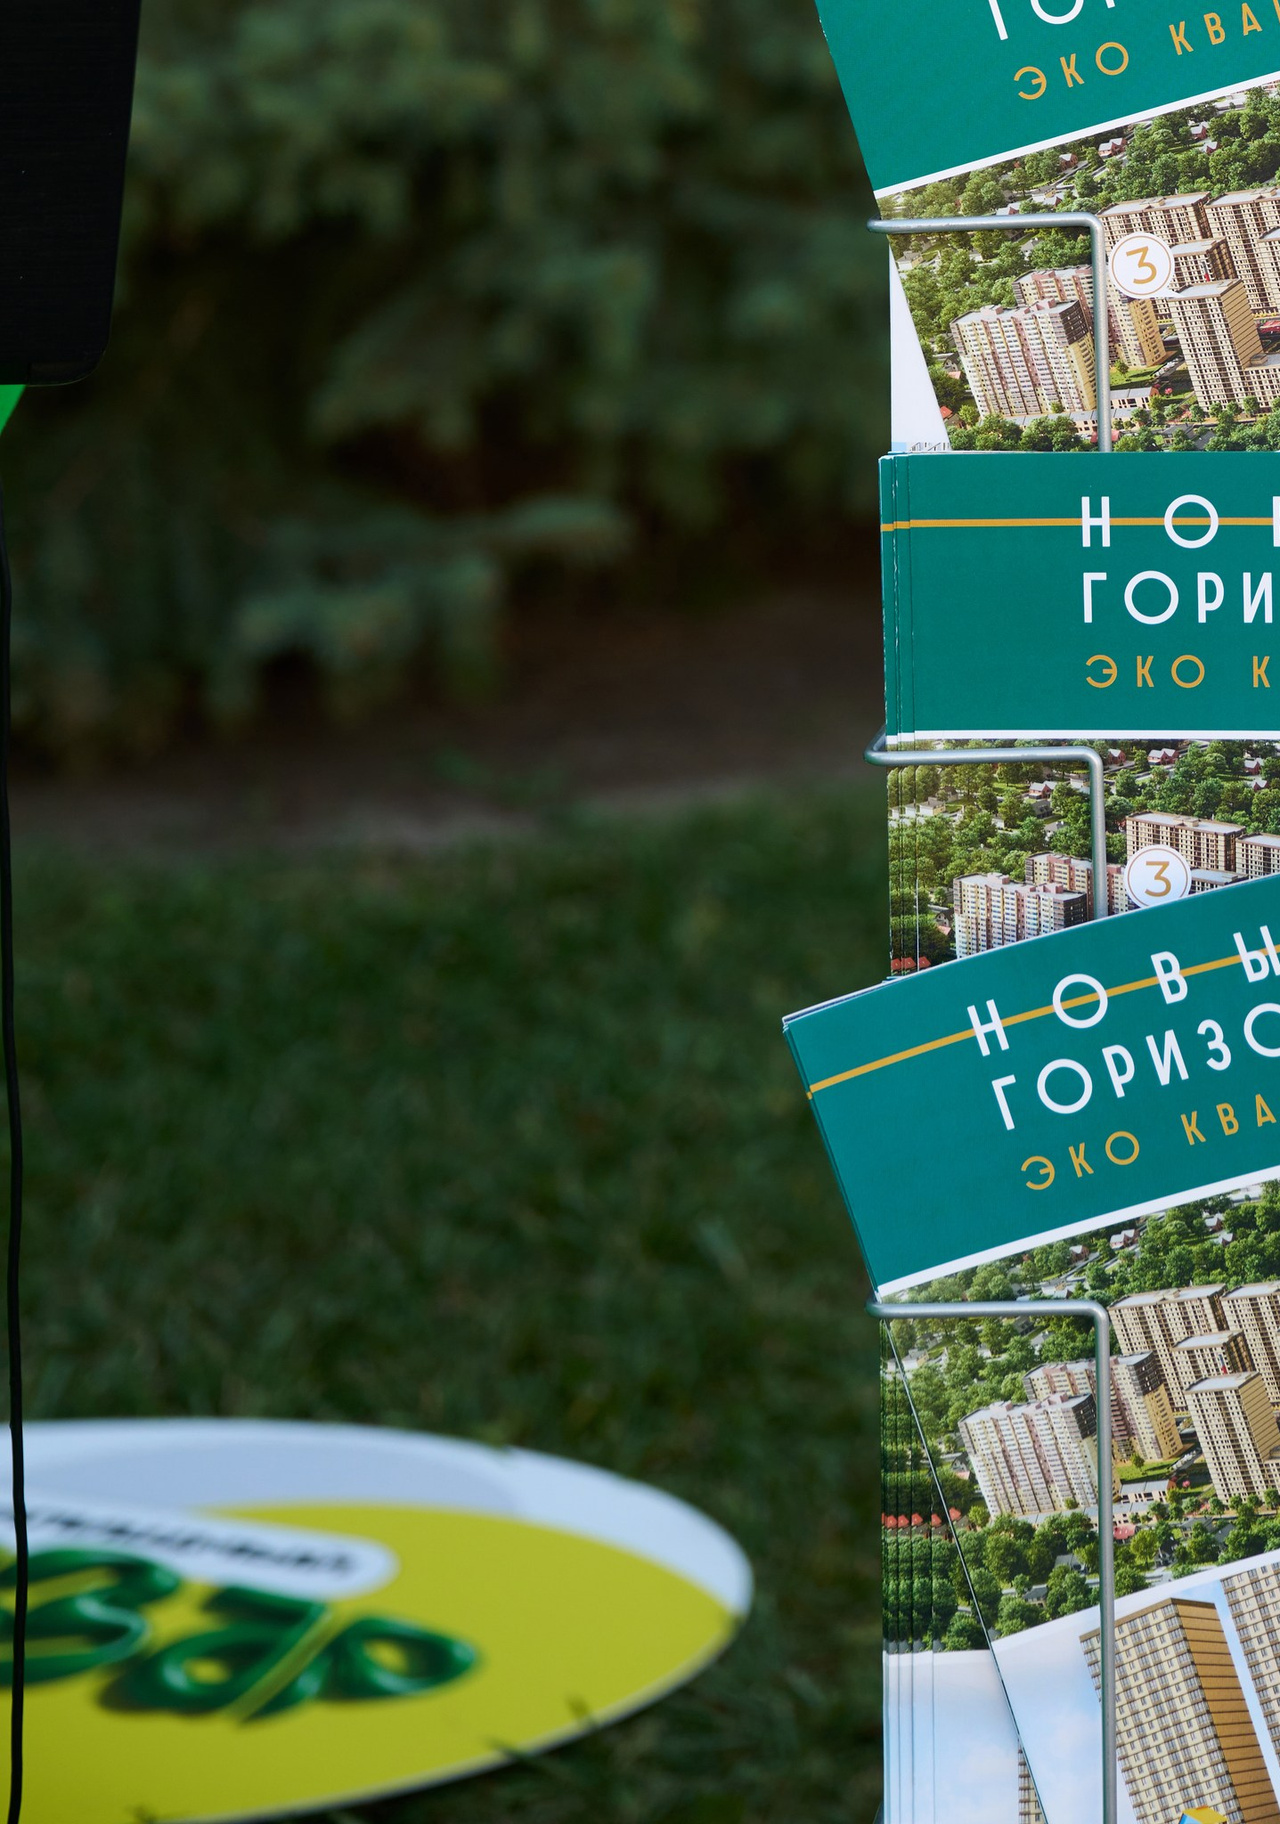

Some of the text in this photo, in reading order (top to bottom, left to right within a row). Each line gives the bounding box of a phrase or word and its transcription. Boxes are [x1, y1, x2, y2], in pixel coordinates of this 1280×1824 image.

[1014, 41, 1130, 100] ЭКО
[1125, 246, 1158, 285] 3
[1085, 654, 1205, 688] ЭКО
[1144, 860, 1172, 898] 3
[1021, 1131, 1140, 1190] ЭКО
